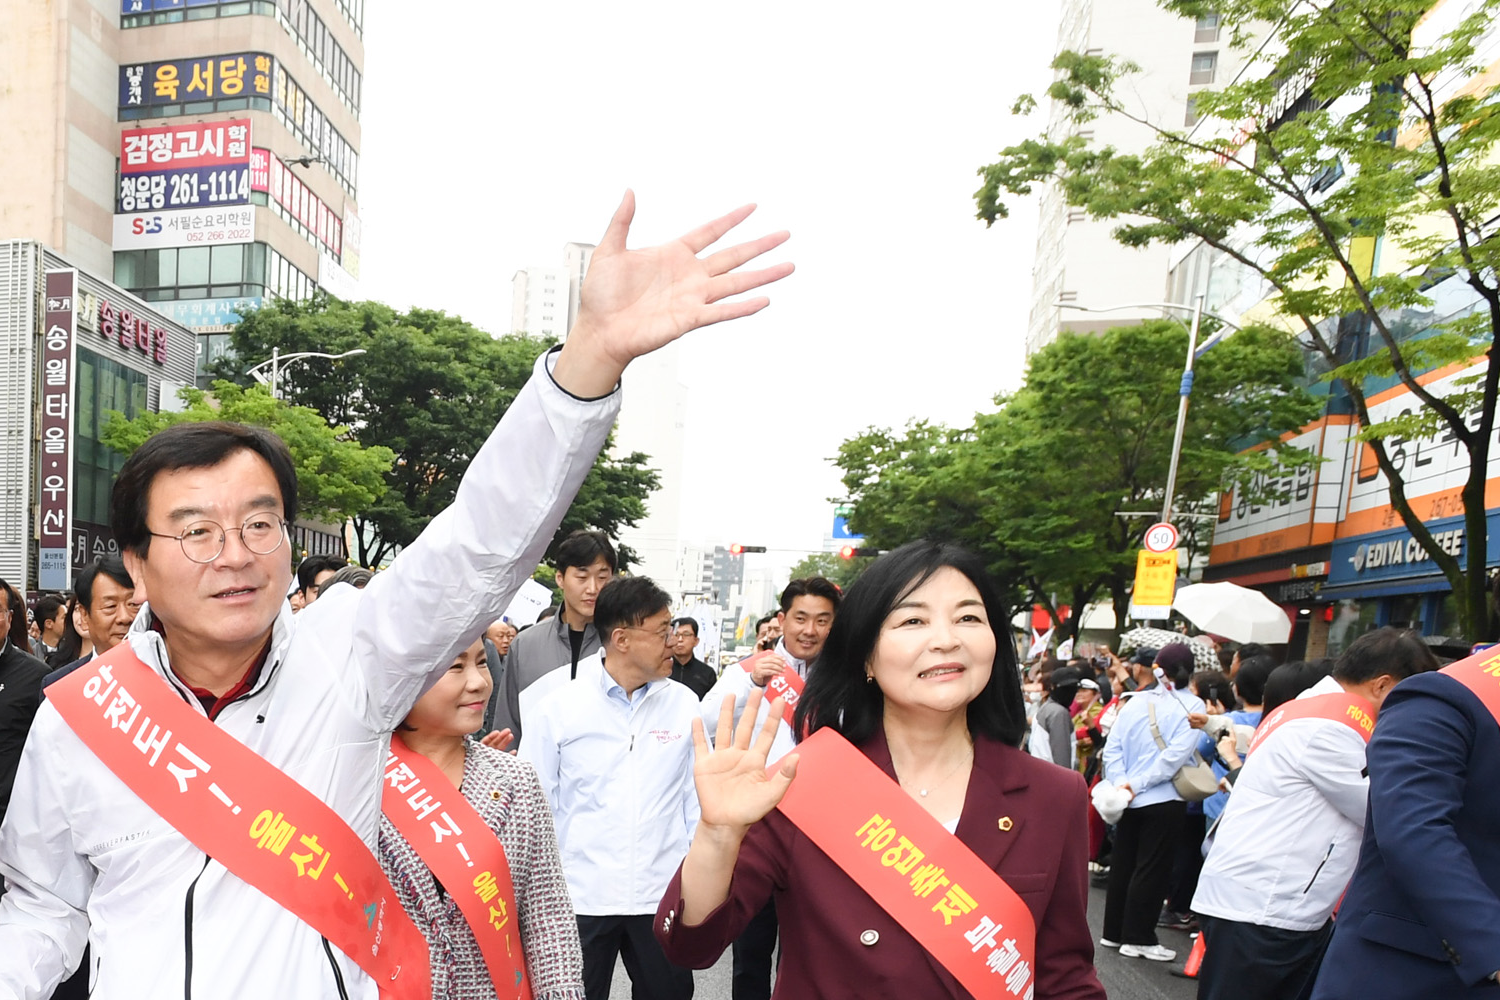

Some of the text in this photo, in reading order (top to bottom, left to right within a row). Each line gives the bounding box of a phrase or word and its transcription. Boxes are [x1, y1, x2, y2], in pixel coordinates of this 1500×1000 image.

[153, 58, 247, 100] 육서당
[253, 56, 270, 93] 학원
[124, 125, 248, 165] 검정고시 학원
[120, 169, 249, 211] 청운당 261-1114
[167, 211, 252, 230] 서필순요리학원
[186, 229, 251, 242] 052 266 2022
[101, 299, 168, 365] 송월타월
[1153, 532, 1169, 545] 50
[1366, 529, 1463, 568] EDIYA COEE
[41, 561, 67, 570] 265-1115
[855, 813, 979, 926] 공업축제
[963, 915, 1031, 997] 부활을
